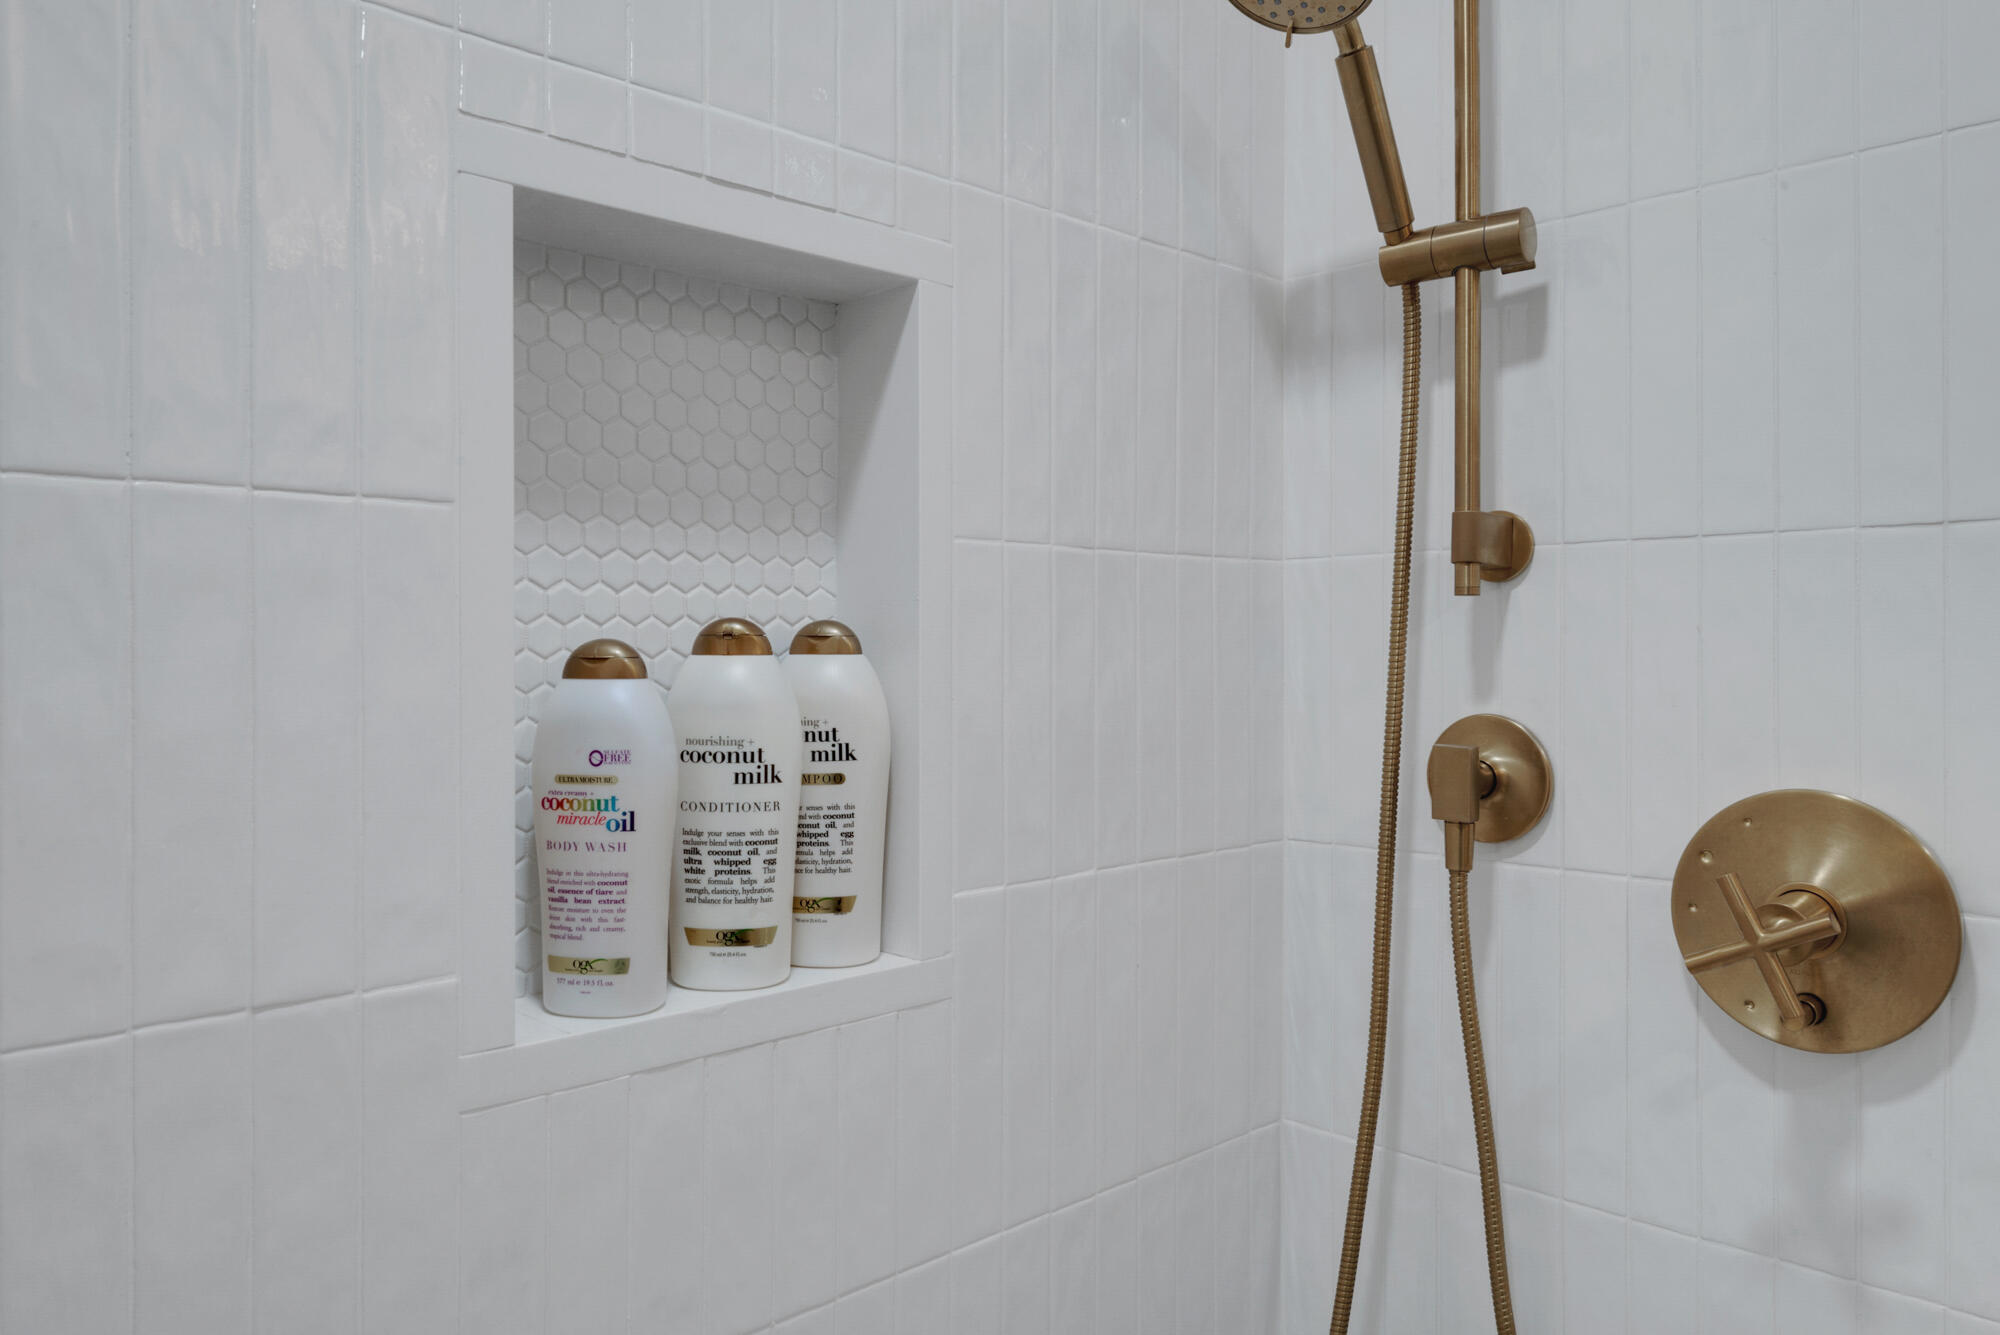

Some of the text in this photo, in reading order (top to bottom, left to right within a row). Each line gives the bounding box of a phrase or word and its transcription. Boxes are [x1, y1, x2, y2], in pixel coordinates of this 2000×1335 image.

[804, 728, 840, 743] nut
[685, 736, 745, 749] nourishing
[680, 748, 765, 764] coconut
[810, 742, 858, 762] milk
[603, 753, 631, 762] FREE
[733, 764, 783, 785] milk
[801, 774, 843, 784] MPOO
[577, 776, 613, 784] MOISTURE
[541, 795, 620, 812] coconut
[680, 800, 780, 813] CONDITIONER
[827, 803, 840, 811] with
[844, 803, 855, 811] this
[823, 812, 855, 820] coconut
[556, 811, 636, 832] miracle oil
[682, 827, 704, 838] Indulge
[768, 828, 779, 836] this
[546, 840, 627, 853] BODY WASH
[682, 838, 778, 847] exclusive blend with coconut
[766, 847, 778, 855] and
[820, 849, 835, 857] helps
[683, 857, 777, 867] ultra whipped egg
[821, 857, 853, 866] hydration,
[684, 866, 776, 877] white proteins. This
[815, 867, 837, 875] healthy
[708, 877, 734, 885] formula
[740, 877, 758, 886] helps
[764, 876, 775, 884] add
[685, 887, 774, 896] strength, elasticity, hydration,
[686, 896, 696, 904] and
[698, 896, 721, 904] balance
[723, 896, 733, 904] for
[734, 896, 758, 905] healthy
